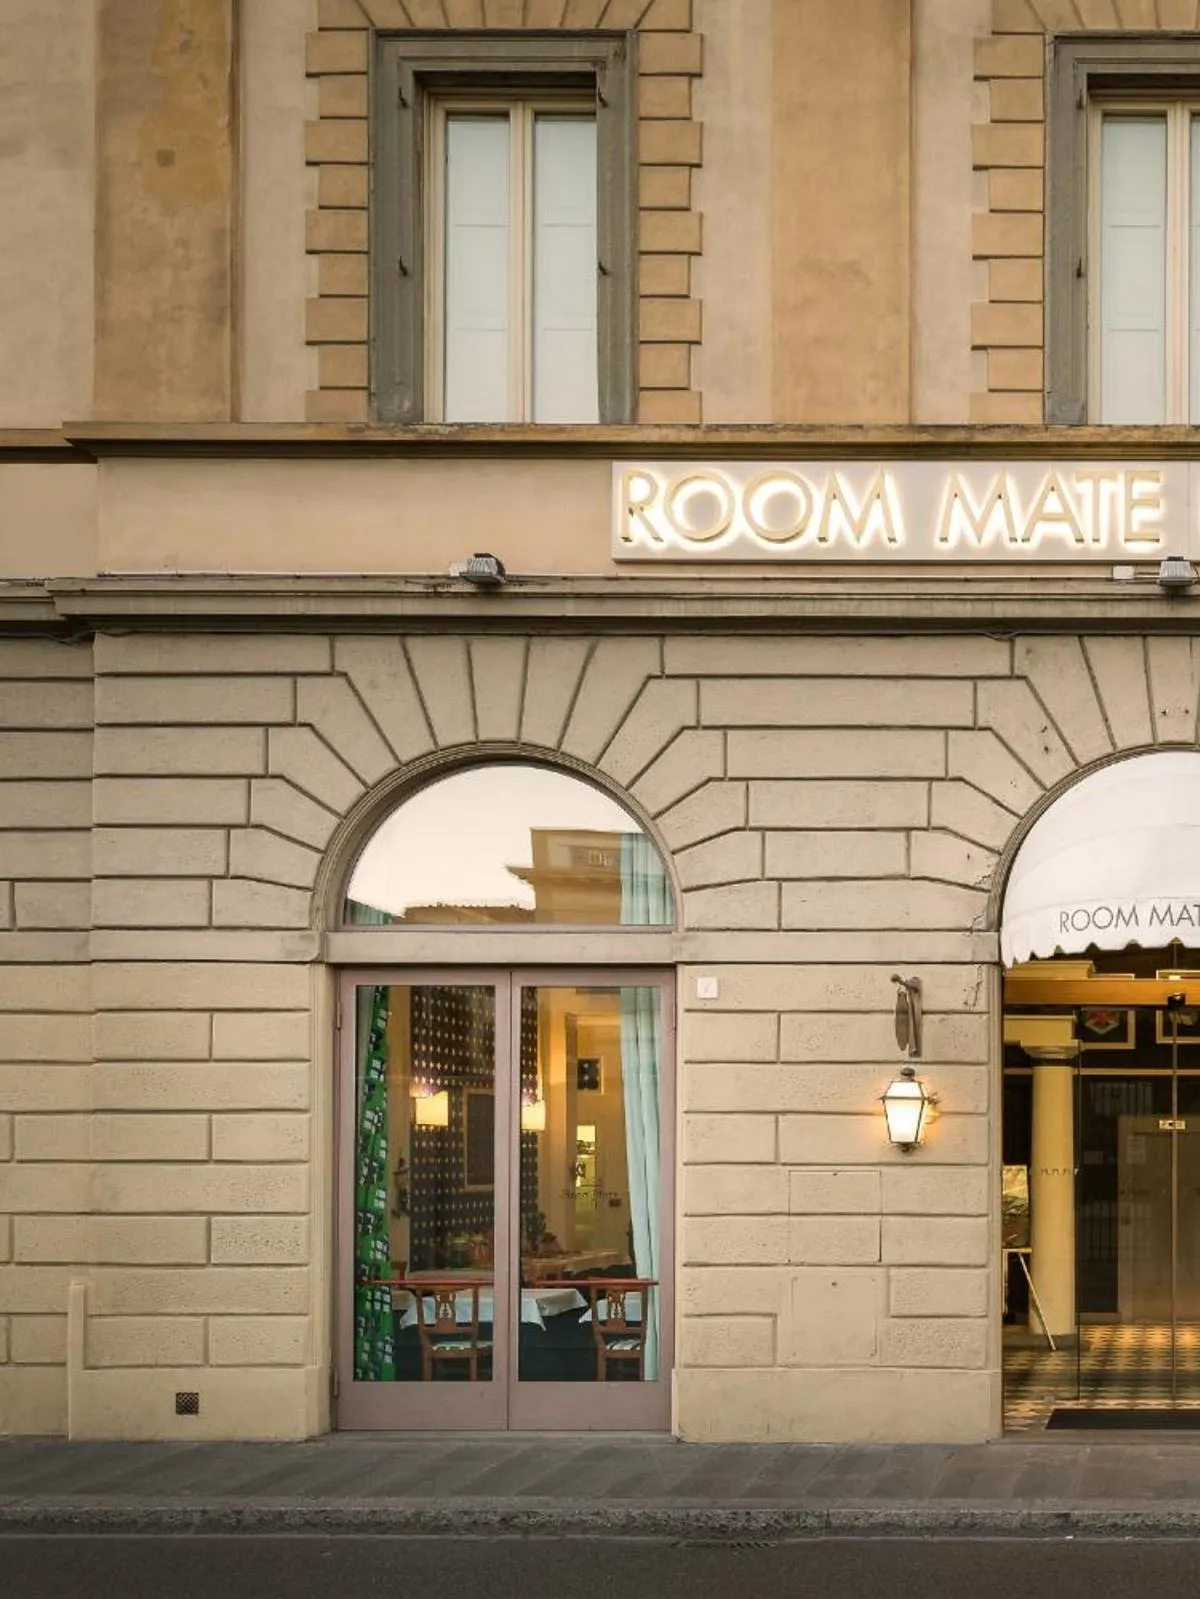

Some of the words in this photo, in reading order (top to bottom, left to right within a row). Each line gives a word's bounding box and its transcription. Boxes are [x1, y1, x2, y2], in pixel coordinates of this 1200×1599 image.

[620, 468, 900, 544] ROOM
[939, 468, 1164, 544] MATE
[1059, 904, 1139, 933] ROOM
